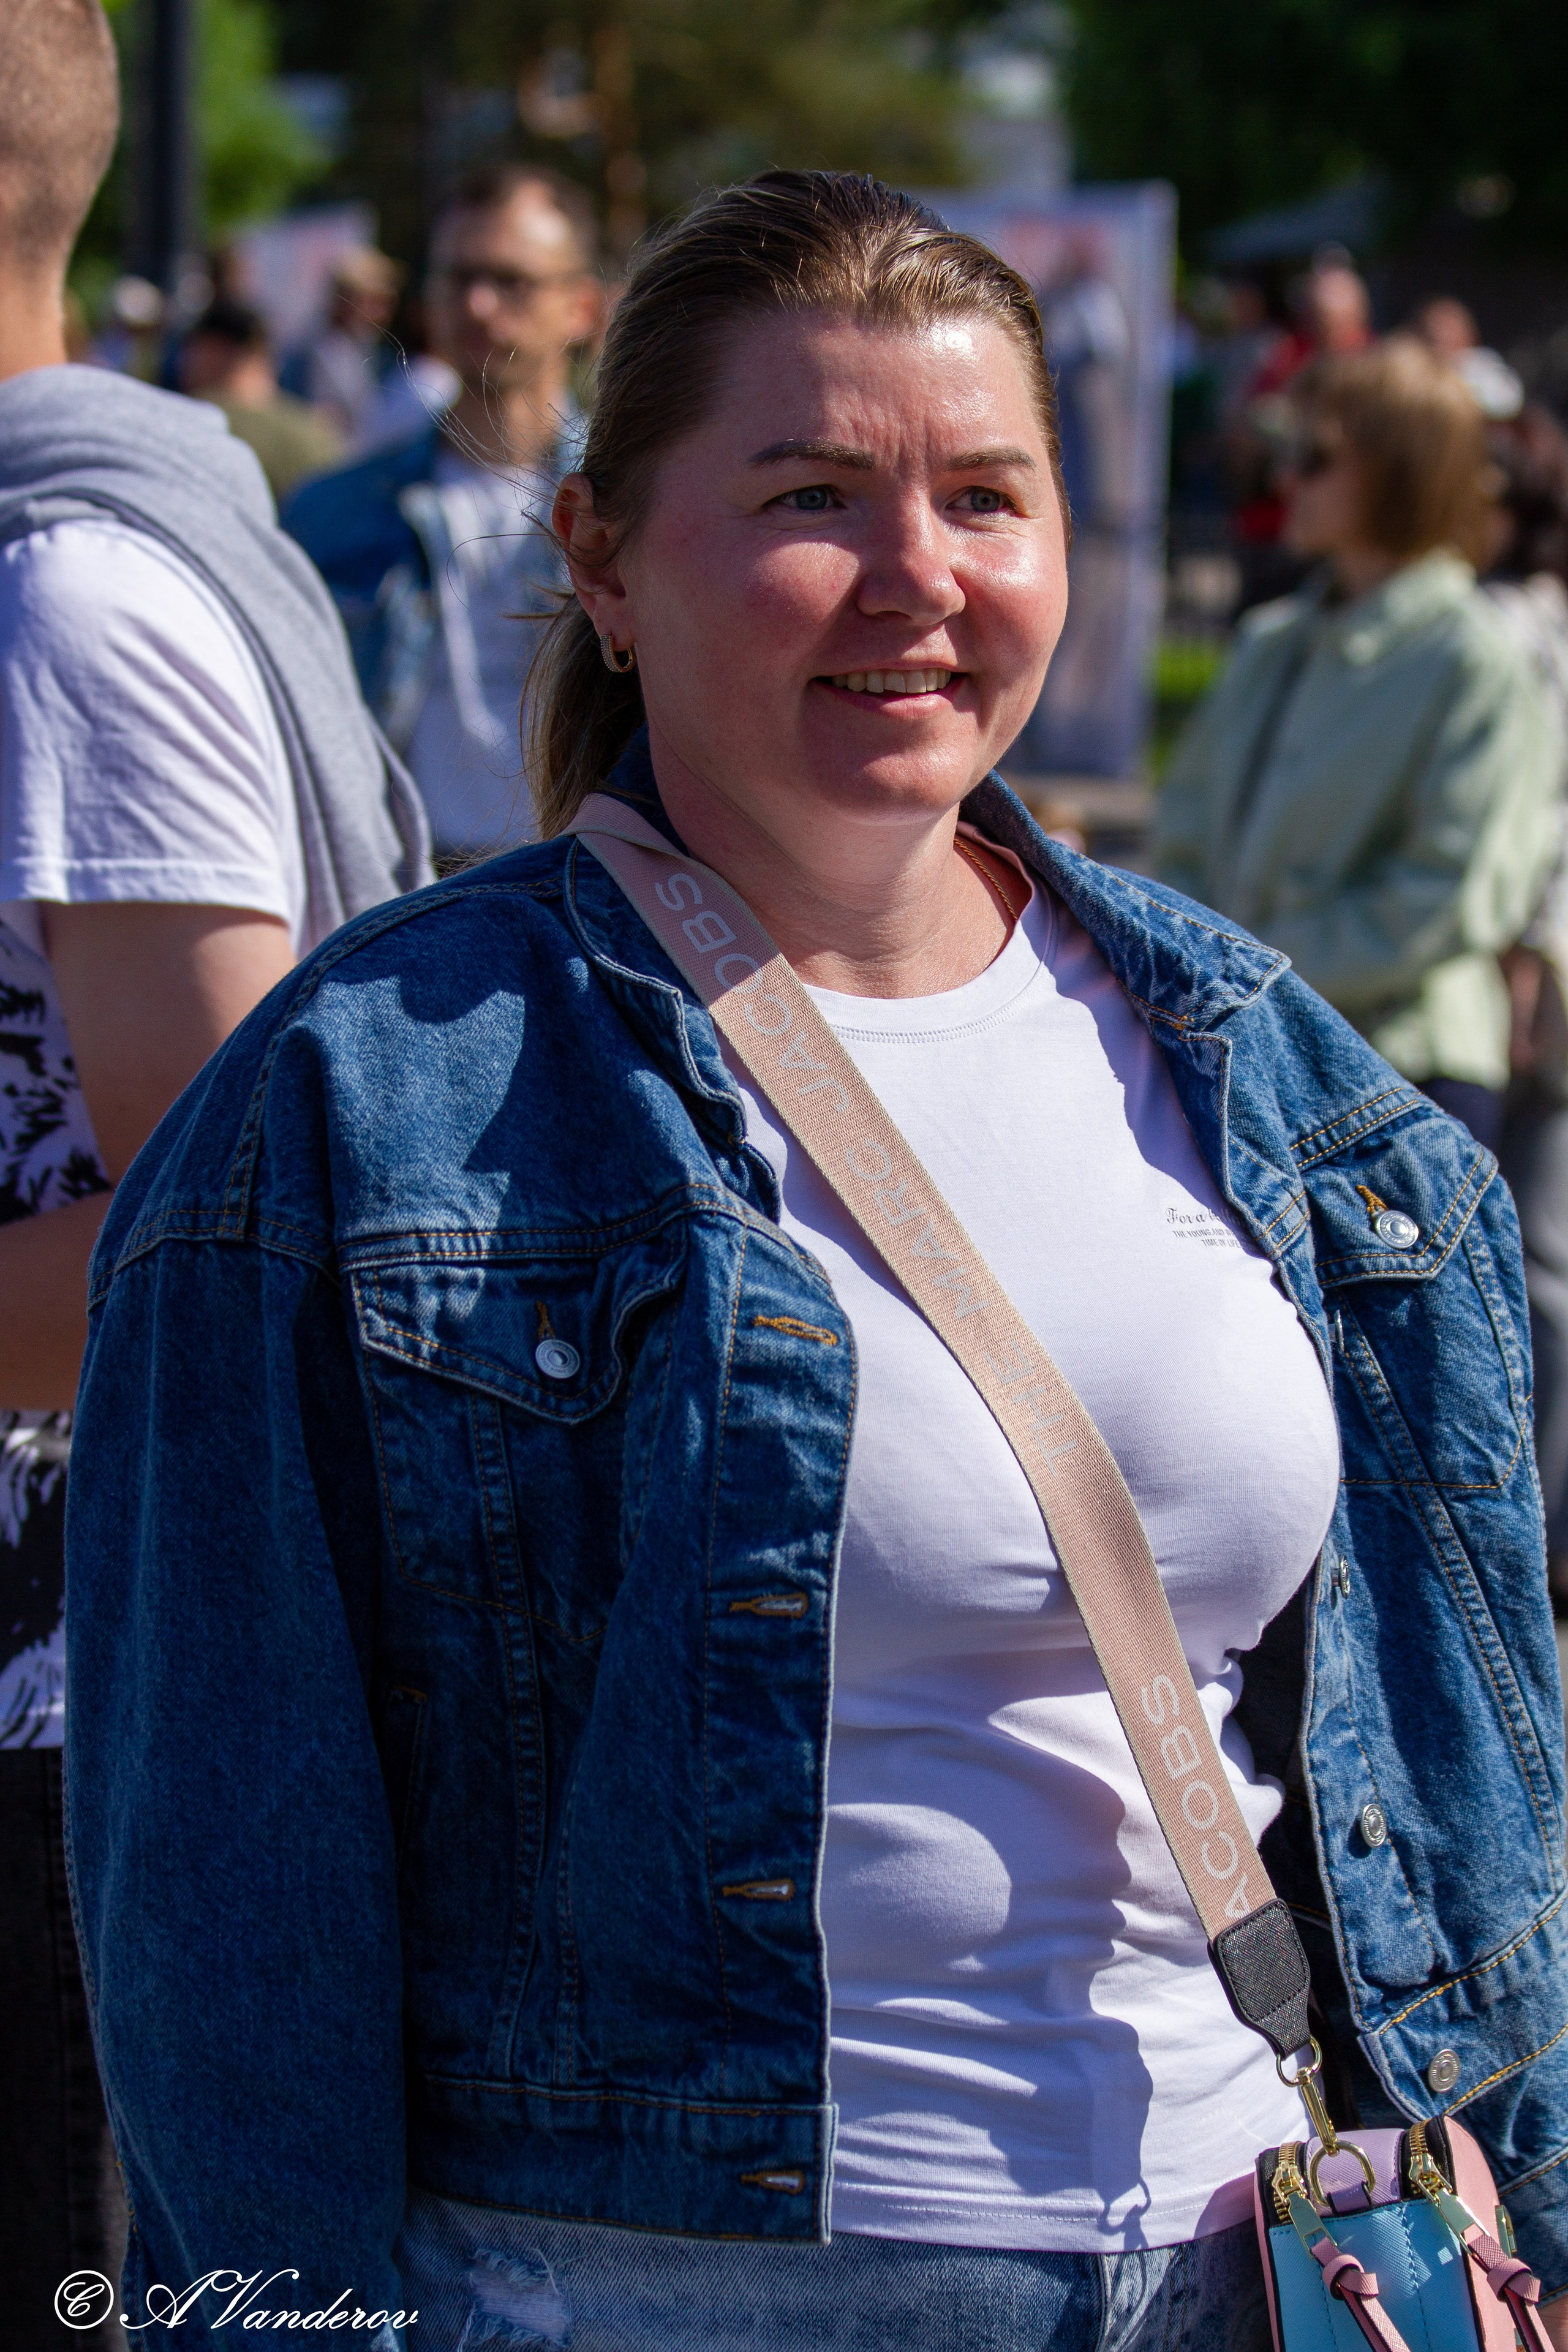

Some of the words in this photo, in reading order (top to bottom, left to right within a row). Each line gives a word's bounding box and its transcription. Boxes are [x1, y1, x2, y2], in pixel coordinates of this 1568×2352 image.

[655, 872, 851, 1112] JACOBS
[844, 1140, 990, 1319] MARC
[1165, 1208, 1194, 1224] For
[1186, 1229, 1212, 1237] YOUNG
[985, 1348, 1077, 1479] THE
